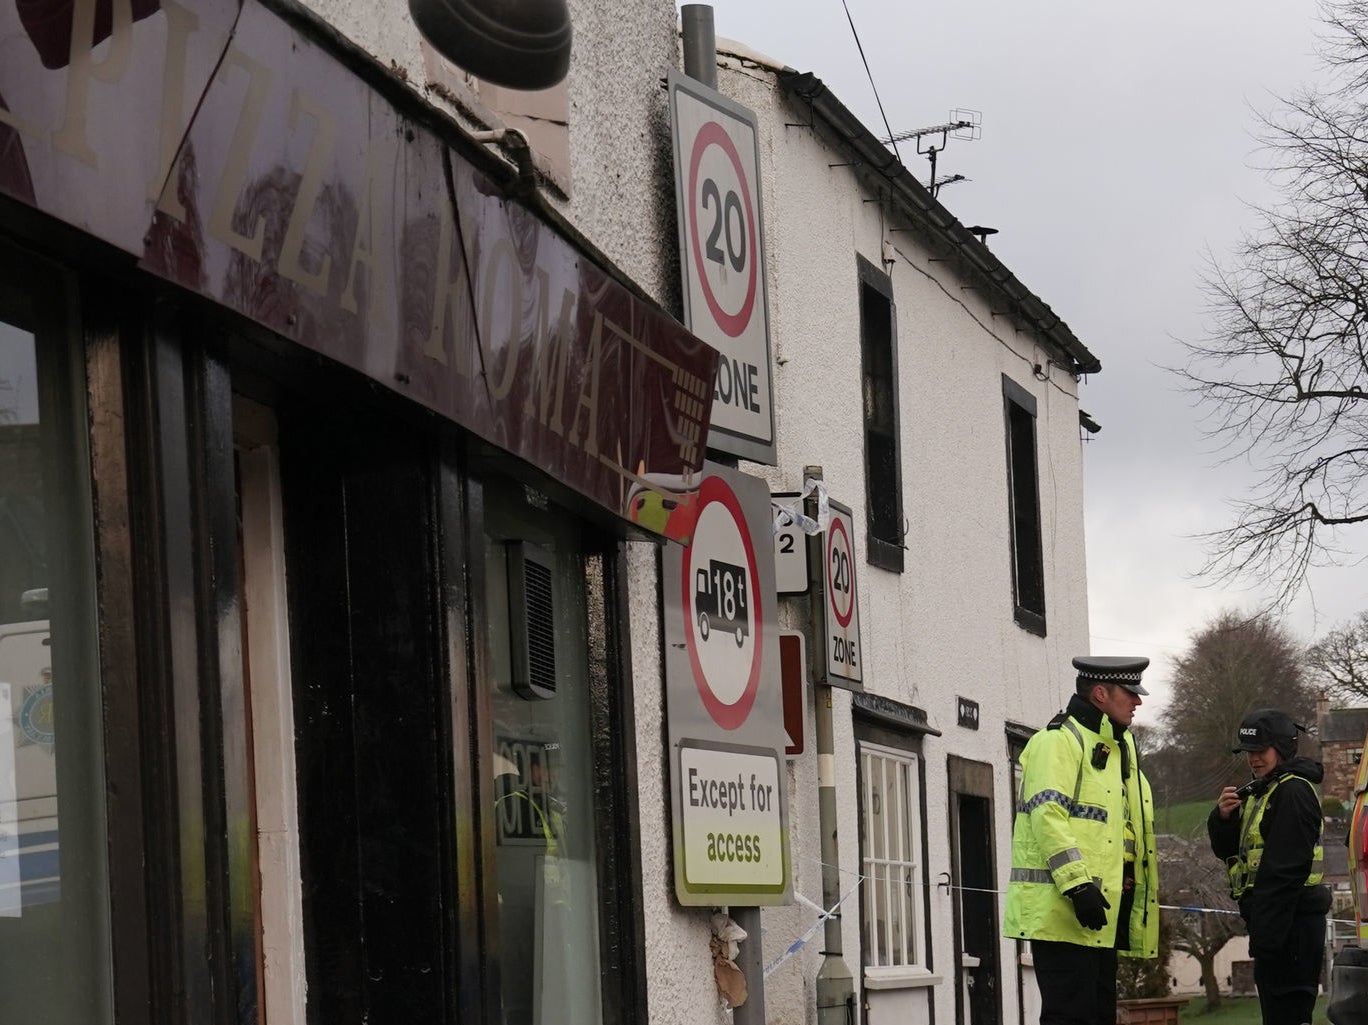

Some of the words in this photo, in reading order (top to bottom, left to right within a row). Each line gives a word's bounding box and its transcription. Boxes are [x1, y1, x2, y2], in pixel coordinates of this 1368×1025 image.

[51, 0, 397, 337] PIZZA
[423, 197, 604, 461] ROMA
[702, 178, 746, 273] 20
[713, 354, 760, 414] ONE
[832, 547, 850, 594] 20
[833, 636, 856, 667] ZONE
[1239, 728, 1257, 736] POLICE
[689, 768, 745, 817] Except
[750, 774, 772, 812] for
[707, 832, 761, 863] access
